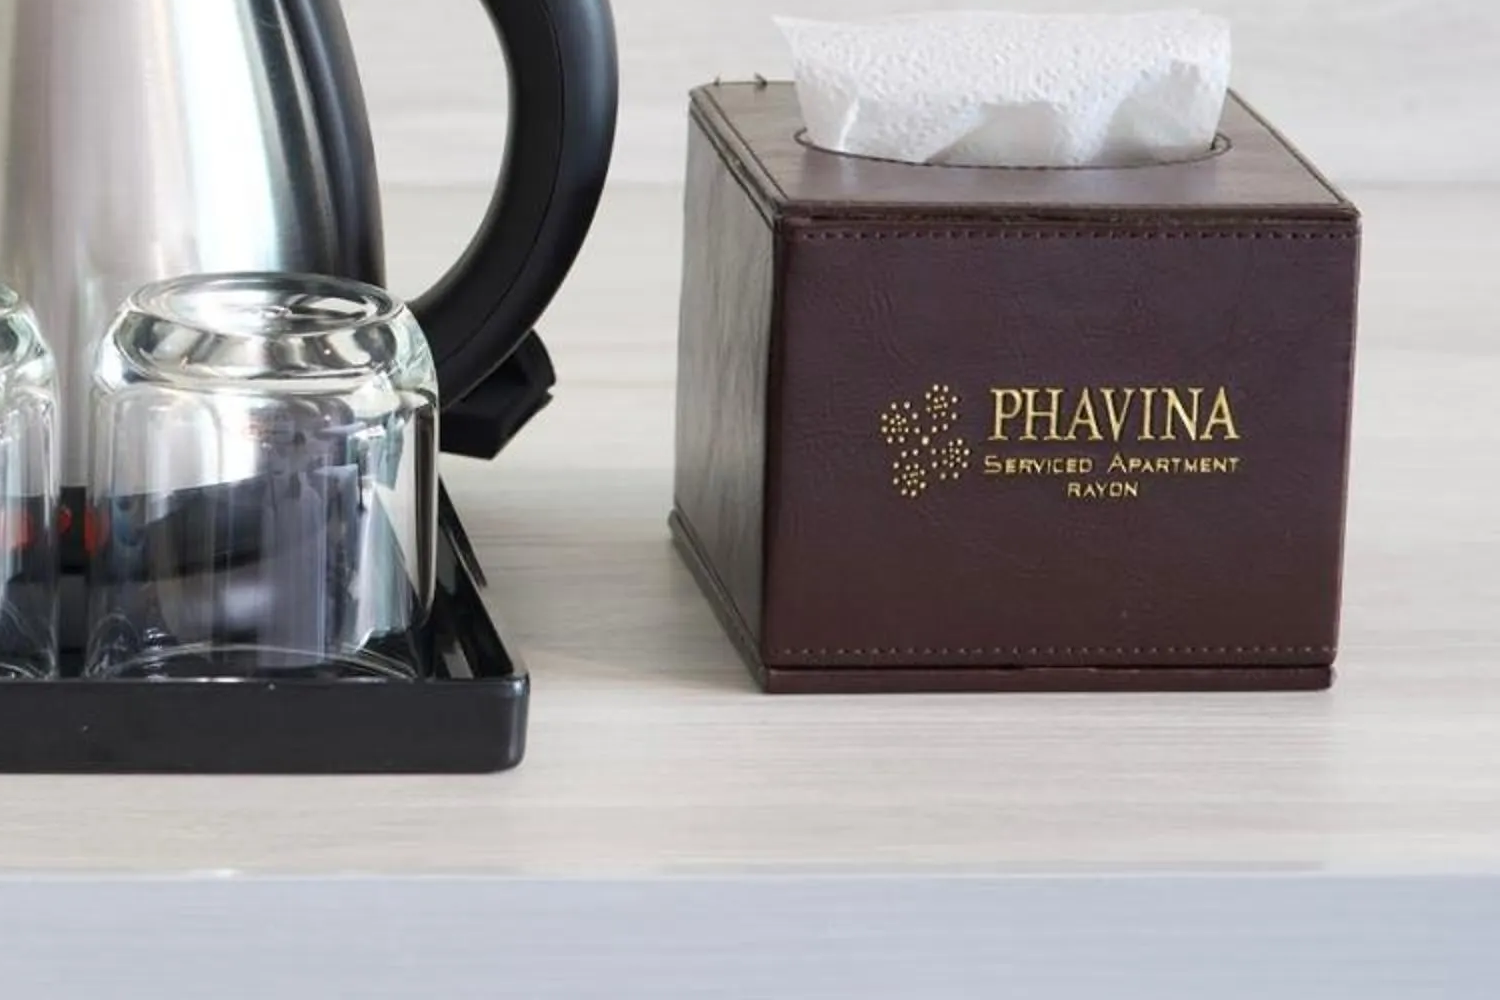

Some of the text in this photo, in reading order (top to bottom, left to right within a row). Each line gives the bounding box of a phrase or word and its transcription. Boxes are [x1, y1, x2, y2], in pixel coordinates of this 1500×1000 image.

[987, 386, 1241, 441] PHAVINA
[983, 453, 1241, 474] SERVICED APARTMENT
[1067, 481, 1140, 497] RAYON
